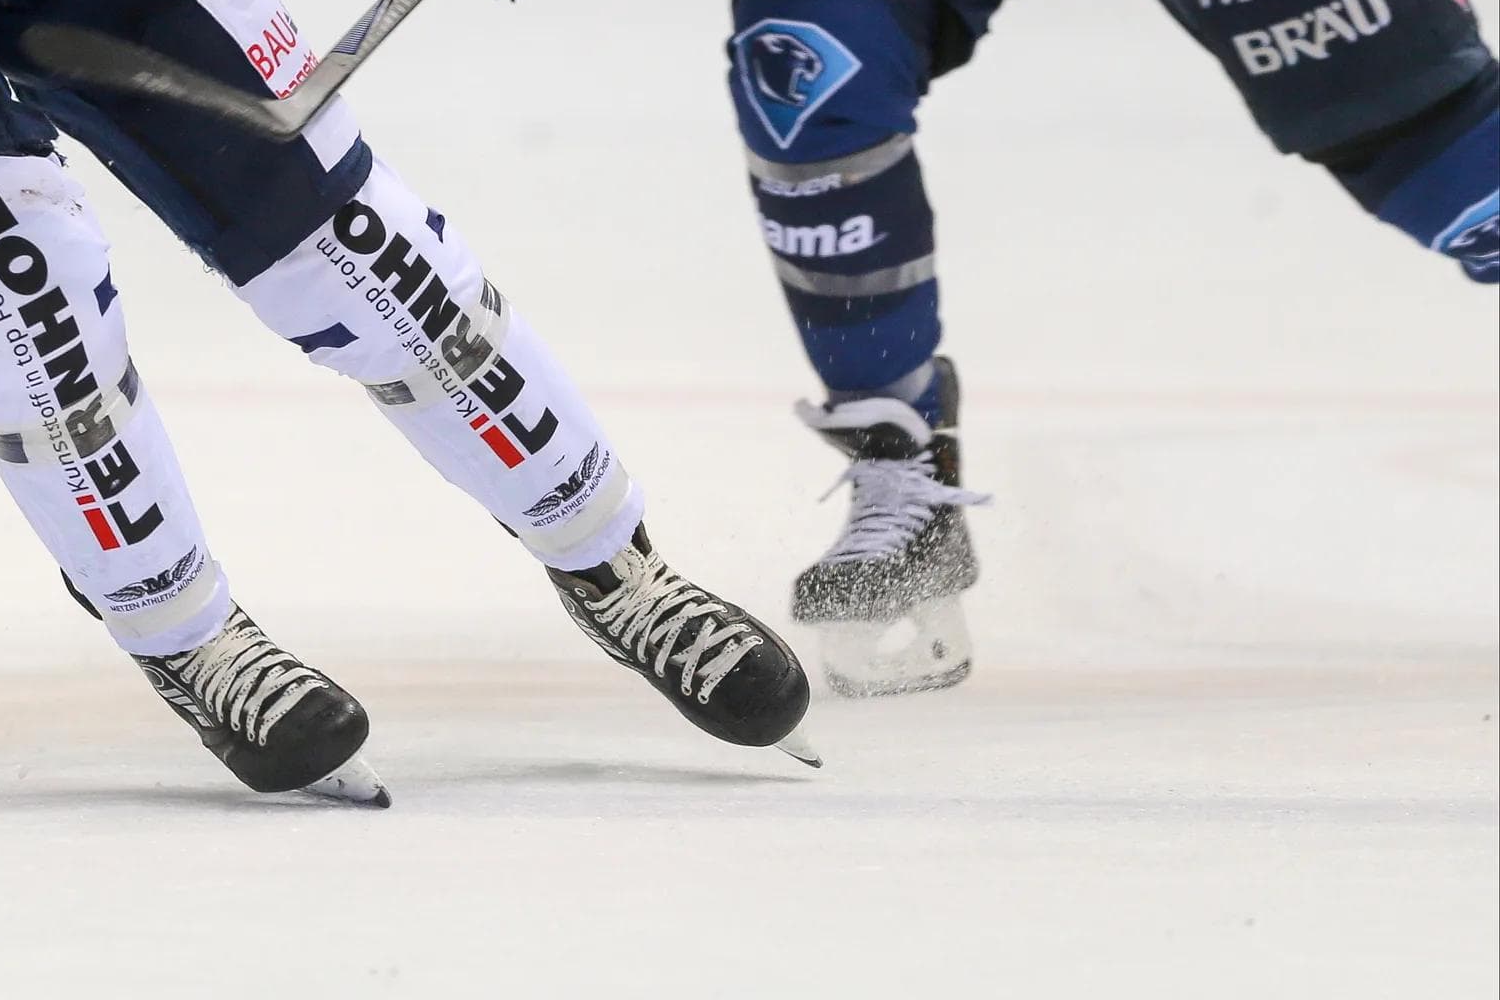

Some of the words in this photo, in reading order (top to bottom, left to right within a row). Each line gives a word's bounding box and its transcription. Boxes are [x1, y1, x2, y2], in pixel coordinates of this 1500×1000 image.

[315, 237, 367, 292] Form
[364, 286, 398, 322] top
[6, 327, 38, 368] top
[26, 370, 46, 391] in
[560, 487, 592, 519] ATHLETIC
[140, 588, 178, 610] ATHLETIC
